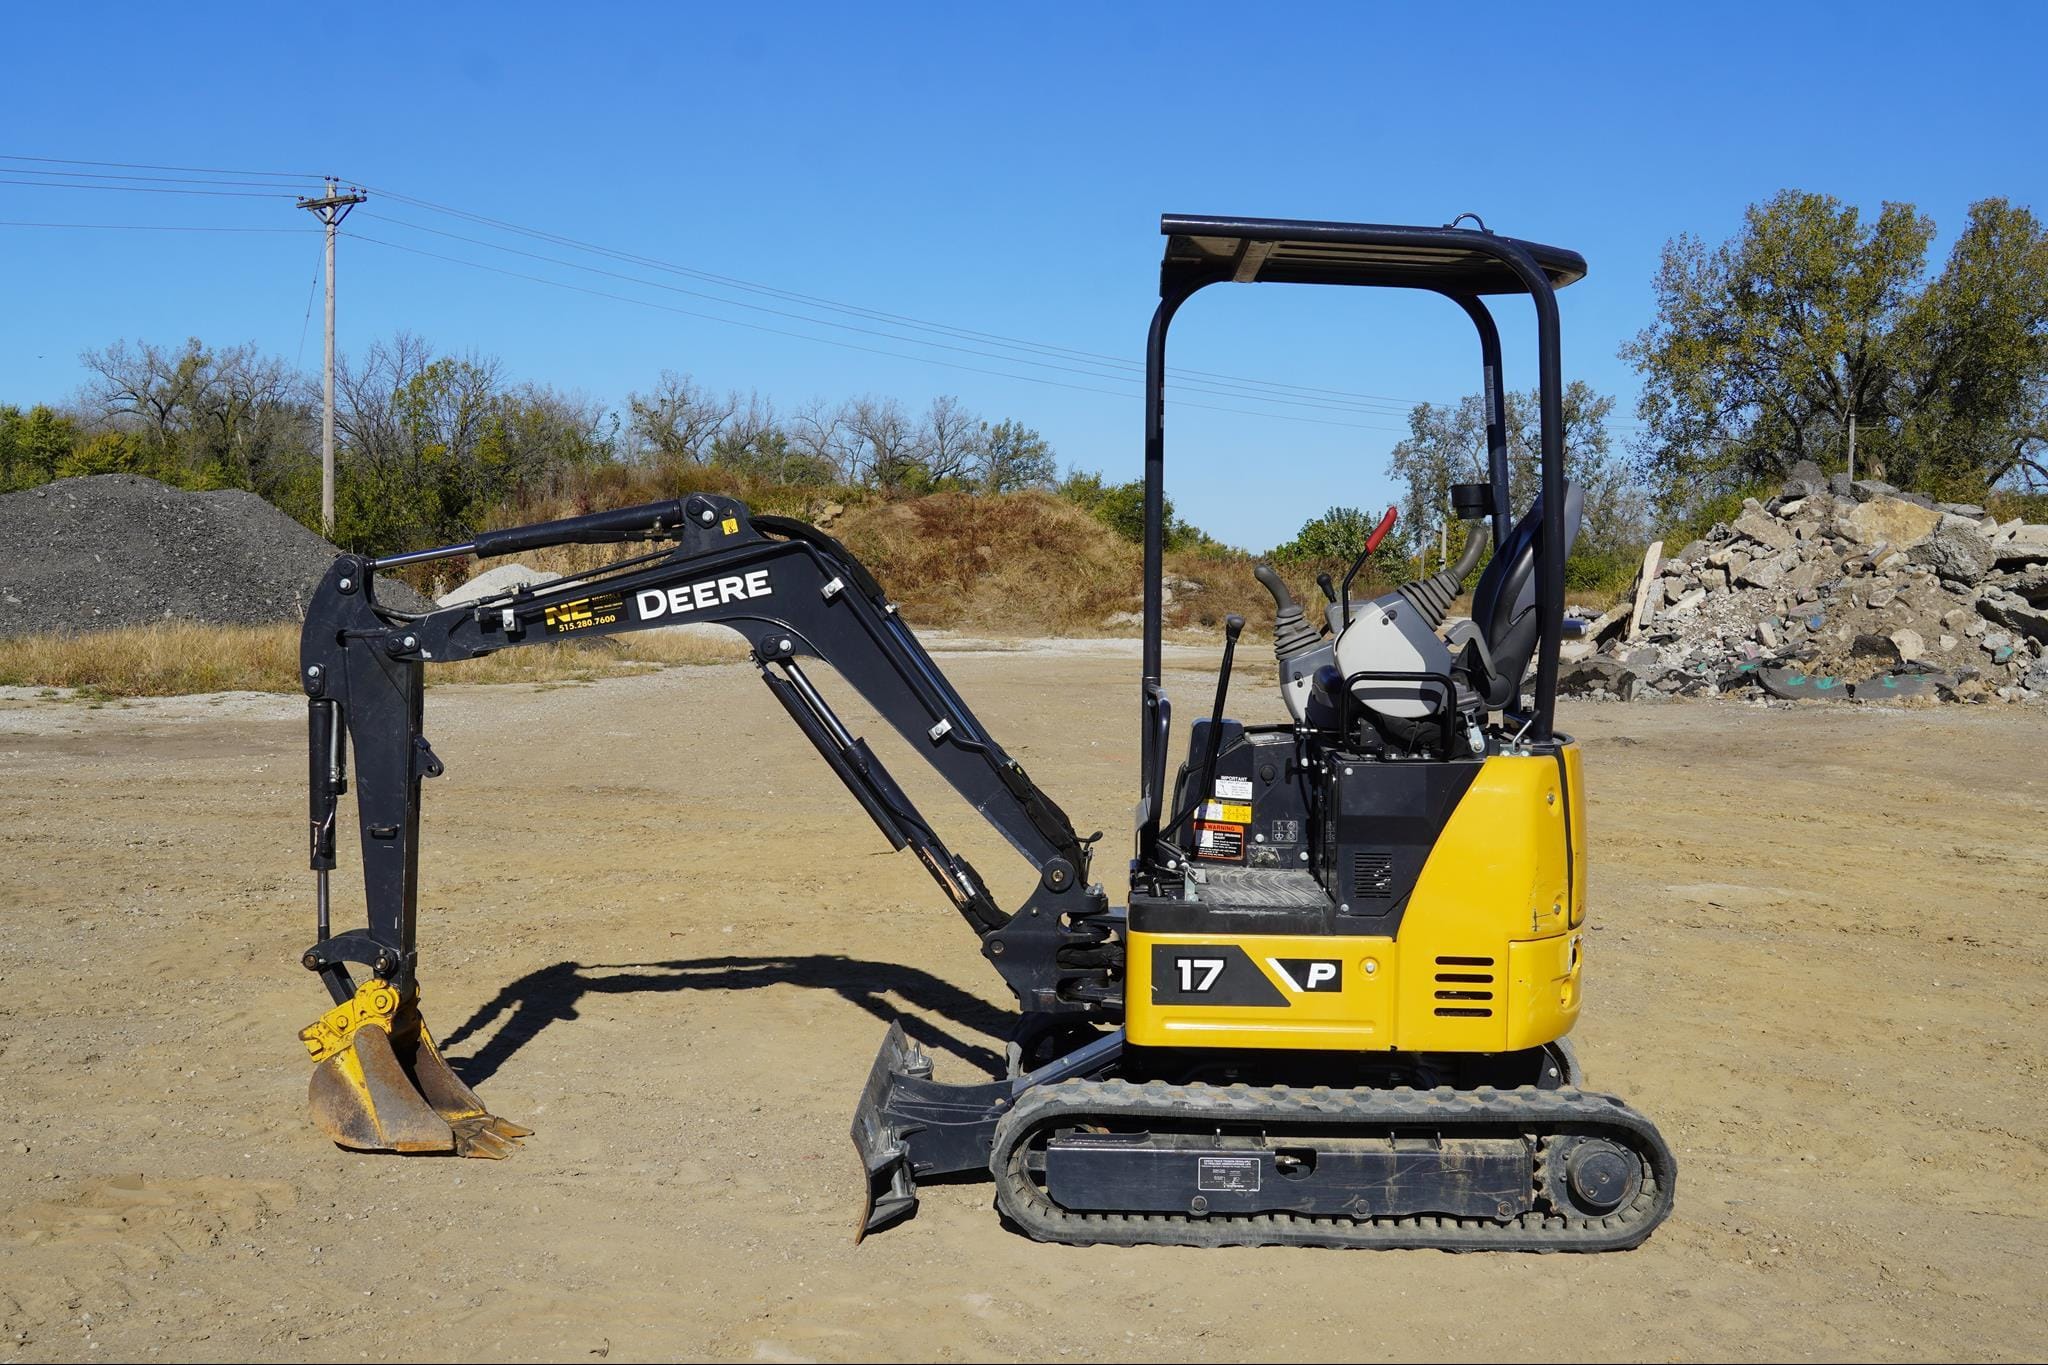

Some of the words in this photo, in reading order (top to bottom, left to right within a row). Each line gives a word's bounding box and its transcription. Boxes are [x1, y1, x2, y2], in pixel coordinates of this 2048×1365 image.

[636, 569, 772, 620] DEERE
[544, 598, 592, 626] NE
[558, 614, 616, 632] 515.280.7600
[1207, 823, 1235, 832] WARNING
[1176, 958, 1225, 992] 17
[1306, 962, 1337, 989] P
